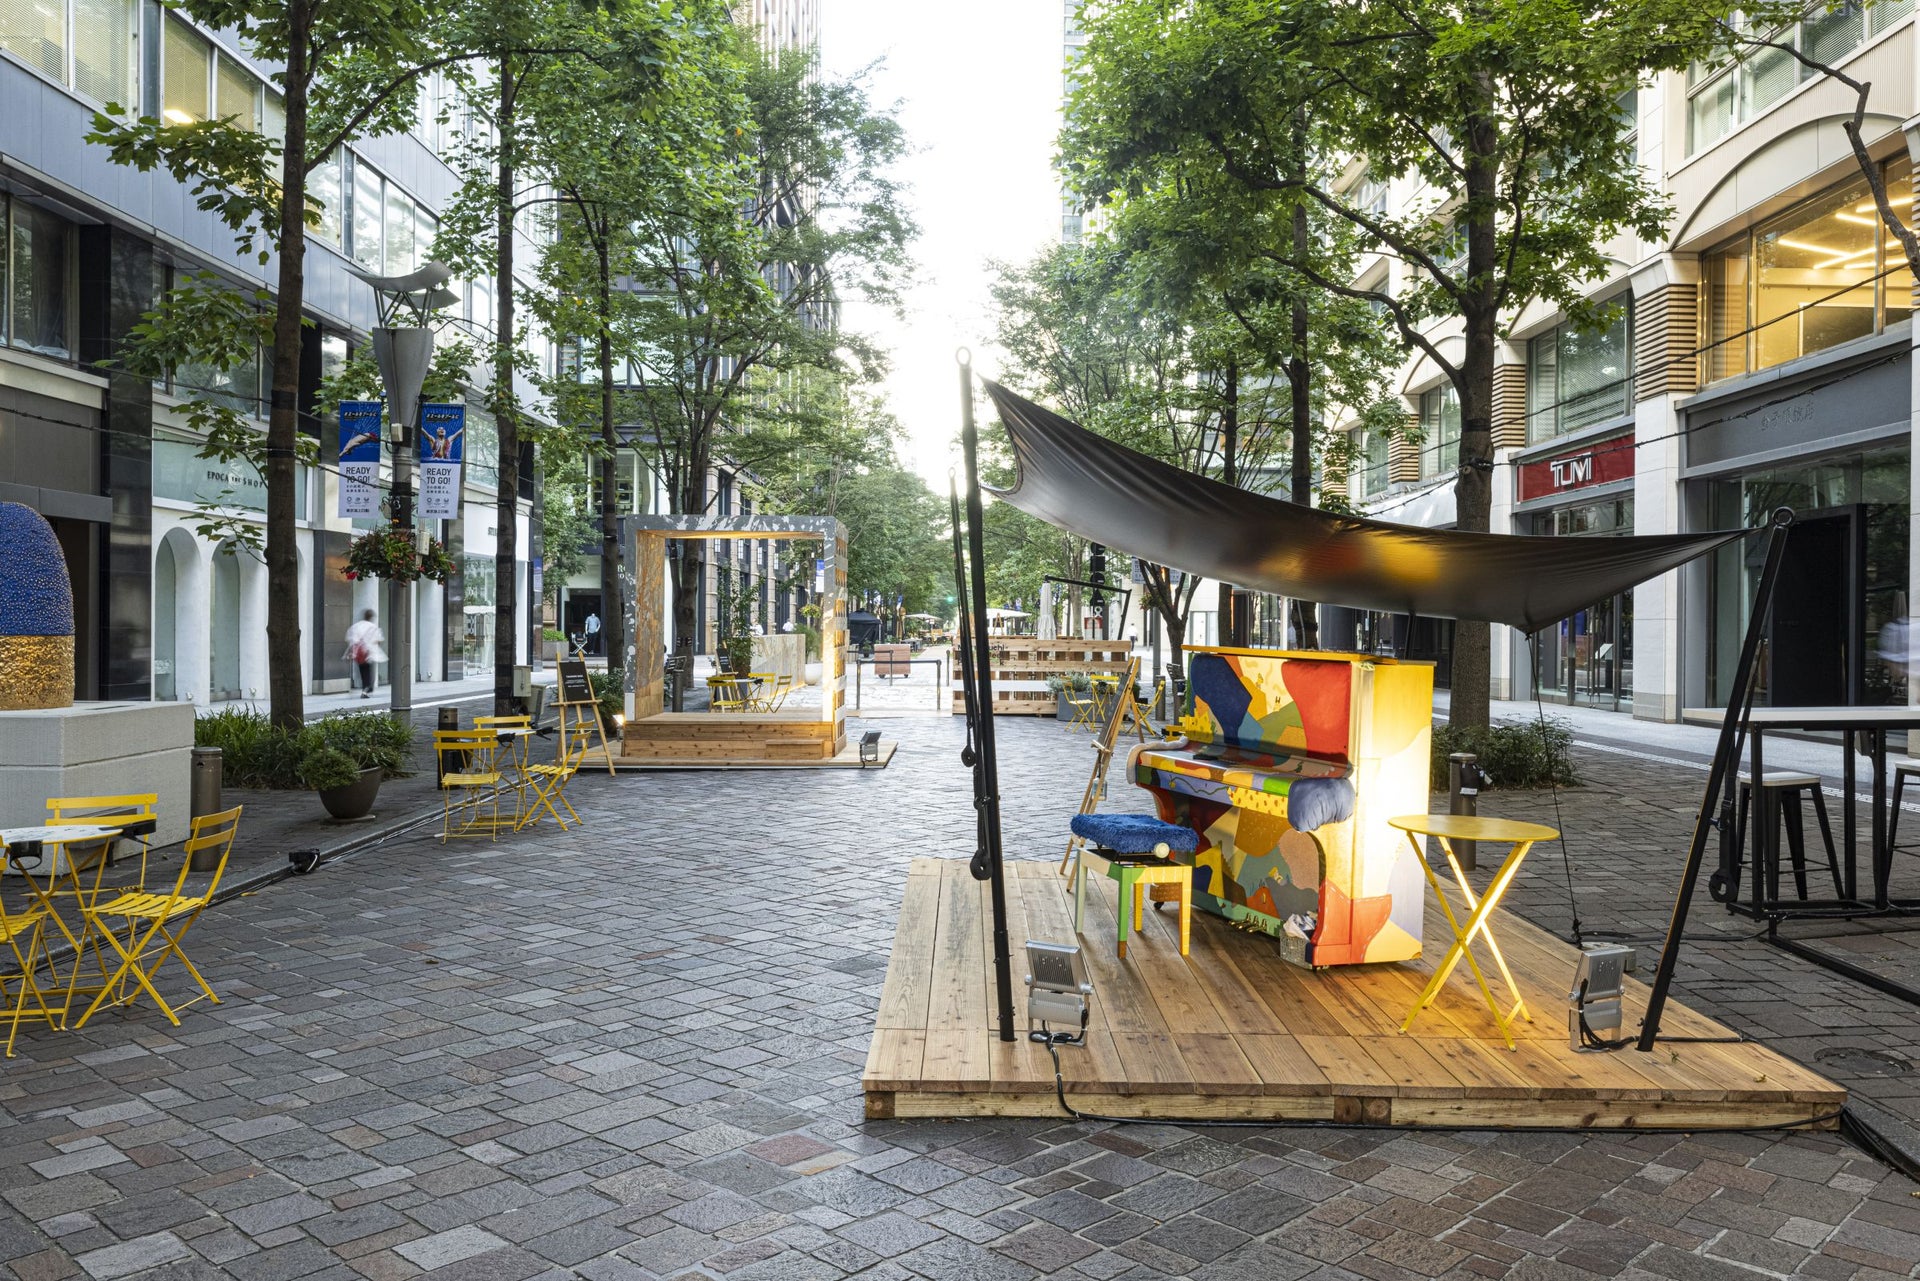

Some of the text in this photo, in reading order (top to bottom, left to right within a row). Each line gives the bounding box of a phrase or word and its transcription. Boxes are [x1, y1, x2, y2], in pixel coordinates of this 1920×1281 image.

[346, 467, 371, 475] READY
[426, 468, 452, 476] READY
[1550, 451, 1592, 488] TUMI
[207, 470, 229, 482] EPOCA
[243, 477, 263, 489] SHOP
[426, 476, 451, 485] TO GO!
